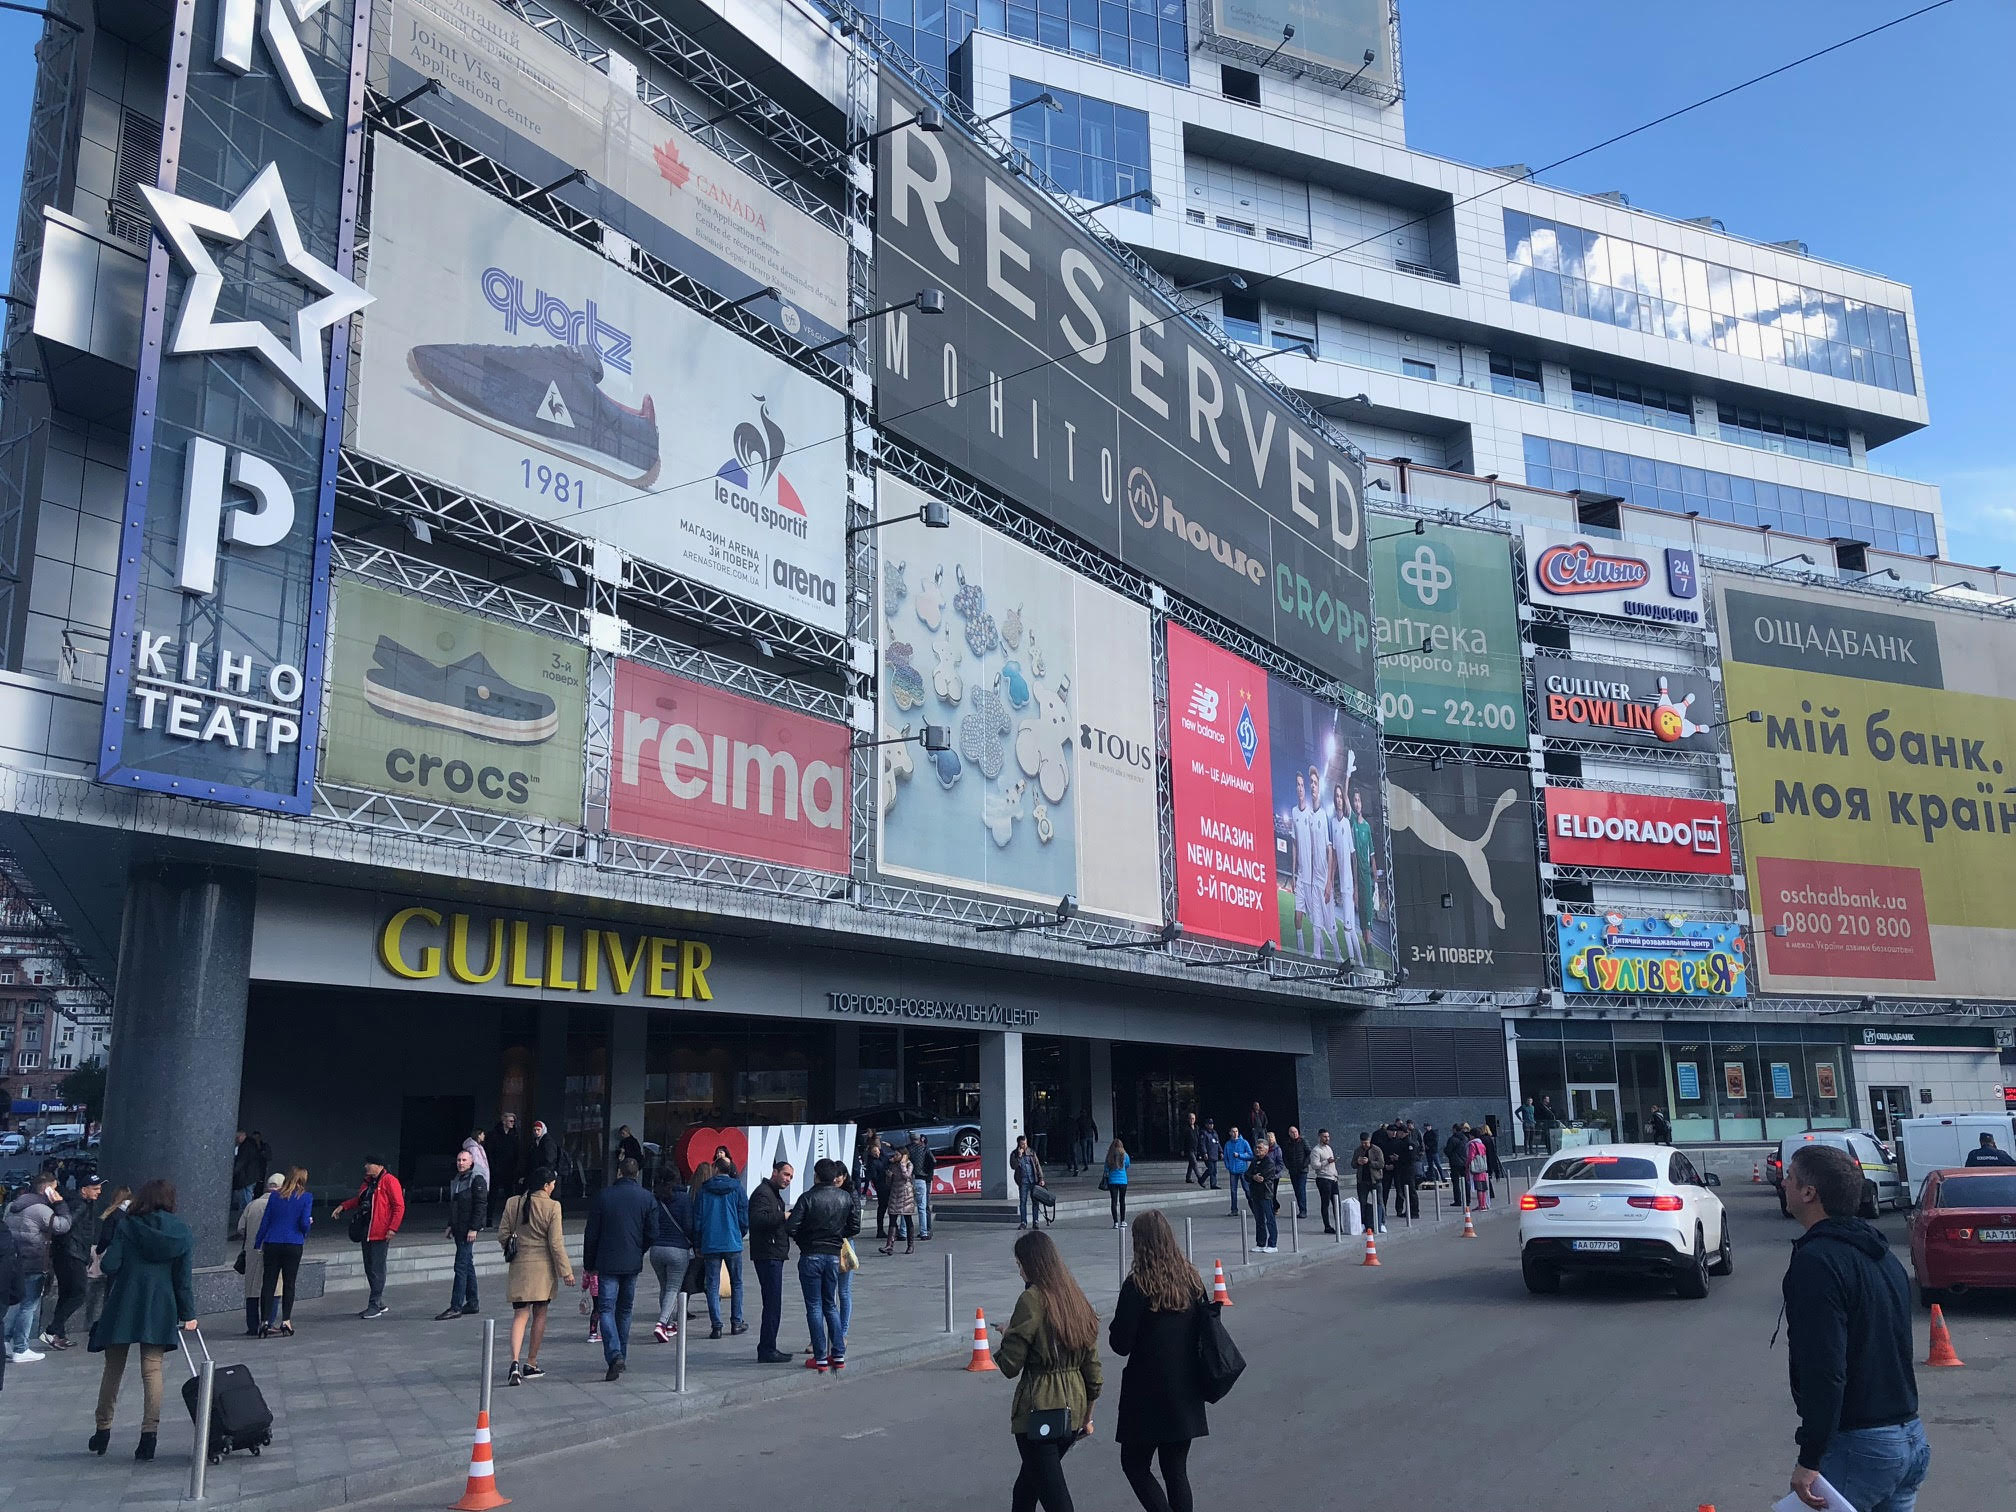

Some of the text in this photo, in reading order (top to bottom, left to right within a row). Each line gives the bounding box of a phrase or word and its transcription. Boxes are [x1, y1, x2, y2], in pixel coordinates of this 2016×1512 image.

[411, 20, 501, 92] Joint Visa
[410, 45, 494, 106] Application
[497, 98, 542, 135] Centre
[696, 174, 767, 233] CANADA
[696, 197, 780, 256] Visa Application Centre
[696, 212, 721, 233] Centre
[722, 229, 731, 240] de
[733, 237, 766, 263] réception
[767, 258, 779, 271] des
[780, 265, 814, 293] demandes
[481, 267, 632, 376] quartz
[892, 98, 1360, 550] RESERVED
[885, 302, 1113, 505] MOHITO
[521, 459, 584, 509] 1981
[714, 479, 808, 540] le coq sportif
[680, 518, 760, 562] МАГАЗИН ARENA
[1163, 495, 1266, 586] house
[683, 549, 760, 587] ARENASTORE.COM.UA
[723, 550, 760, 575] ПОВЕРХ
[773, 558, 836, 608] arena
[1549, 549, 1646, 586] Сільпо
[1674, 559, 1690, 576] 24
[1680, 577, 1689, 593] 7
[1276, 562, 1369, 654] CROPP
[1376, 616, 1488, 655] аптека
[1754, 615, 1918, 665] ОЩАДБАНК
[136, 630, 303, 702] КІНО
[542, 669, 580, 688] поверх
[551, 652, 573, 673] 3-й
[1457, 662, 1490, 678] дня
[1547, 675, 1632, 701] GULLIVER
[134, 686, 300, 755] ТЕАТР
[1181, 717, 1225, 744] new balance
[1444, 699, 1516, 731] 22:00
[1093, 728, 1151, 770] TOUS
[1766, 700, 2003, 775] мій банк.
[385, 748, 529, 805] crocs
[621, 710, 845, 831] reima
[1192, 760, 1205, 776] МИ
[1210, 767, 1220, 783] ЦЕ
[1774, 779, 1872, 822] моя
[1200, 816, 1254, 851] МАГАЗИН
[1555, 813, 1692, 846] ELDORADO
[1697, 829, 1716, 843] UA
[1187, 842, 1266, 883] NEW BALANCE
[1219, 881, 1264, 911] ПОВЕРХ
[1780, 885, 1907, 910] oschadbank.ua
[1612, 935, 1710, 948] Дитячий розважальний центр
[1782, 911, 1911, 938] 0800 210 800
[380, 906, 714, 1000] GULLIVER
[1439, 947, 1495, 965] ПОВЕРХ
[1816, 940, 1844, 951] України
[1845, 944, 1871, 952] дзвінки
[1871, 943, 1914, 954] безкоштовні
[830, 992, 1040, 1029] ТОРГОВО-РОЗВАЖАЛЬНИЙ ЦЕНТР
